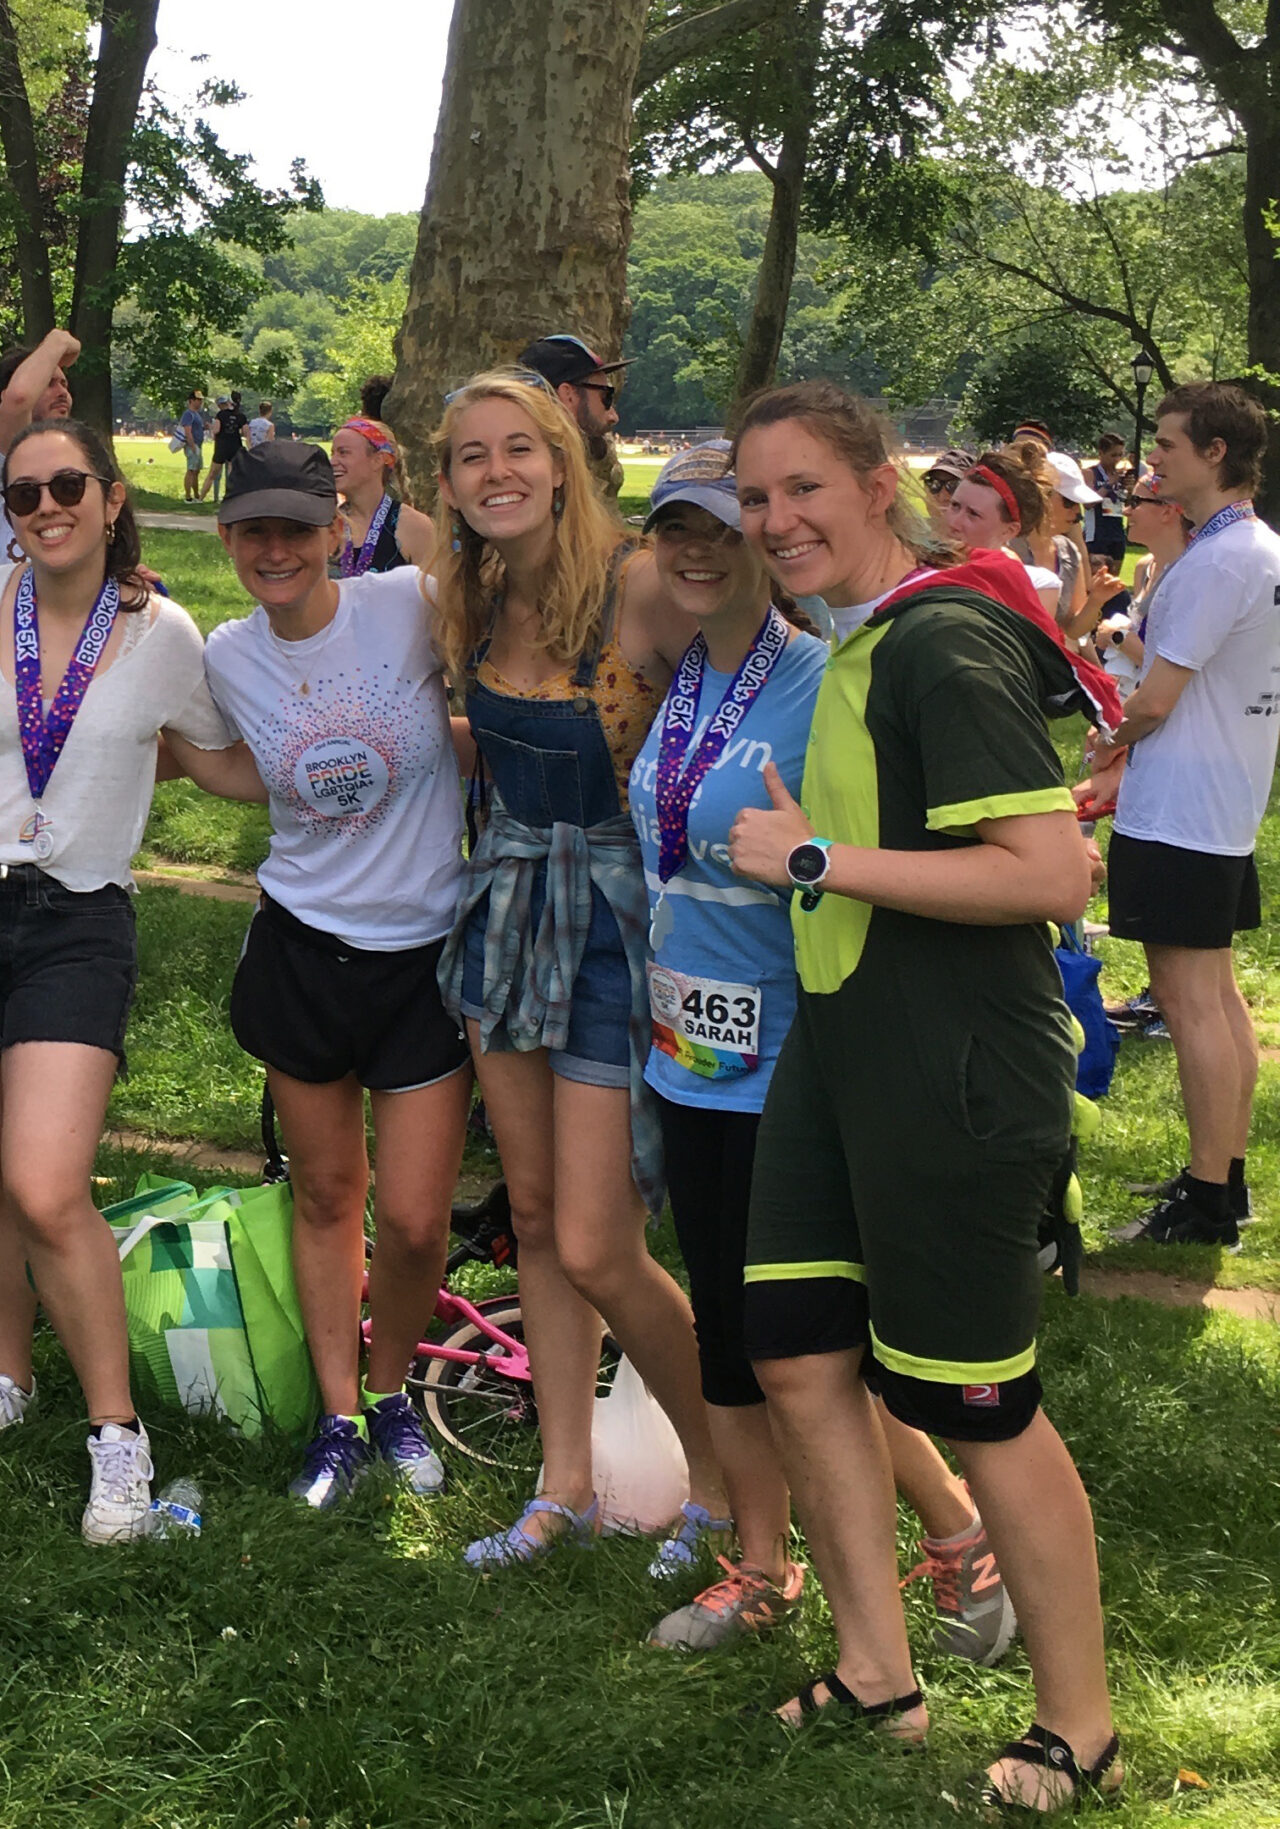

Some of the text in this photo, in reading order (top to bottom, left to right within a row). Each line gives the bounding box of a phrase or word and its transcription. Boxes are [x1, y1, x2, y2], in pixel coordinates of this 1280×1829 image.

[18, 630, 36, 659] 5K
[669, 698, 692, 731] 5K
[714, 703, 743, 739] 5K
[305, 751, 367, 773] BROOKLYN
[308, 762, 372, 790] PRIDE
[314, 780, 374, 799] LGBTQIA+
[337, 791, 361, 807] 5K
[681, 989, 756, 1029] 463
[684, 1020, 752, 1046] SARAH
